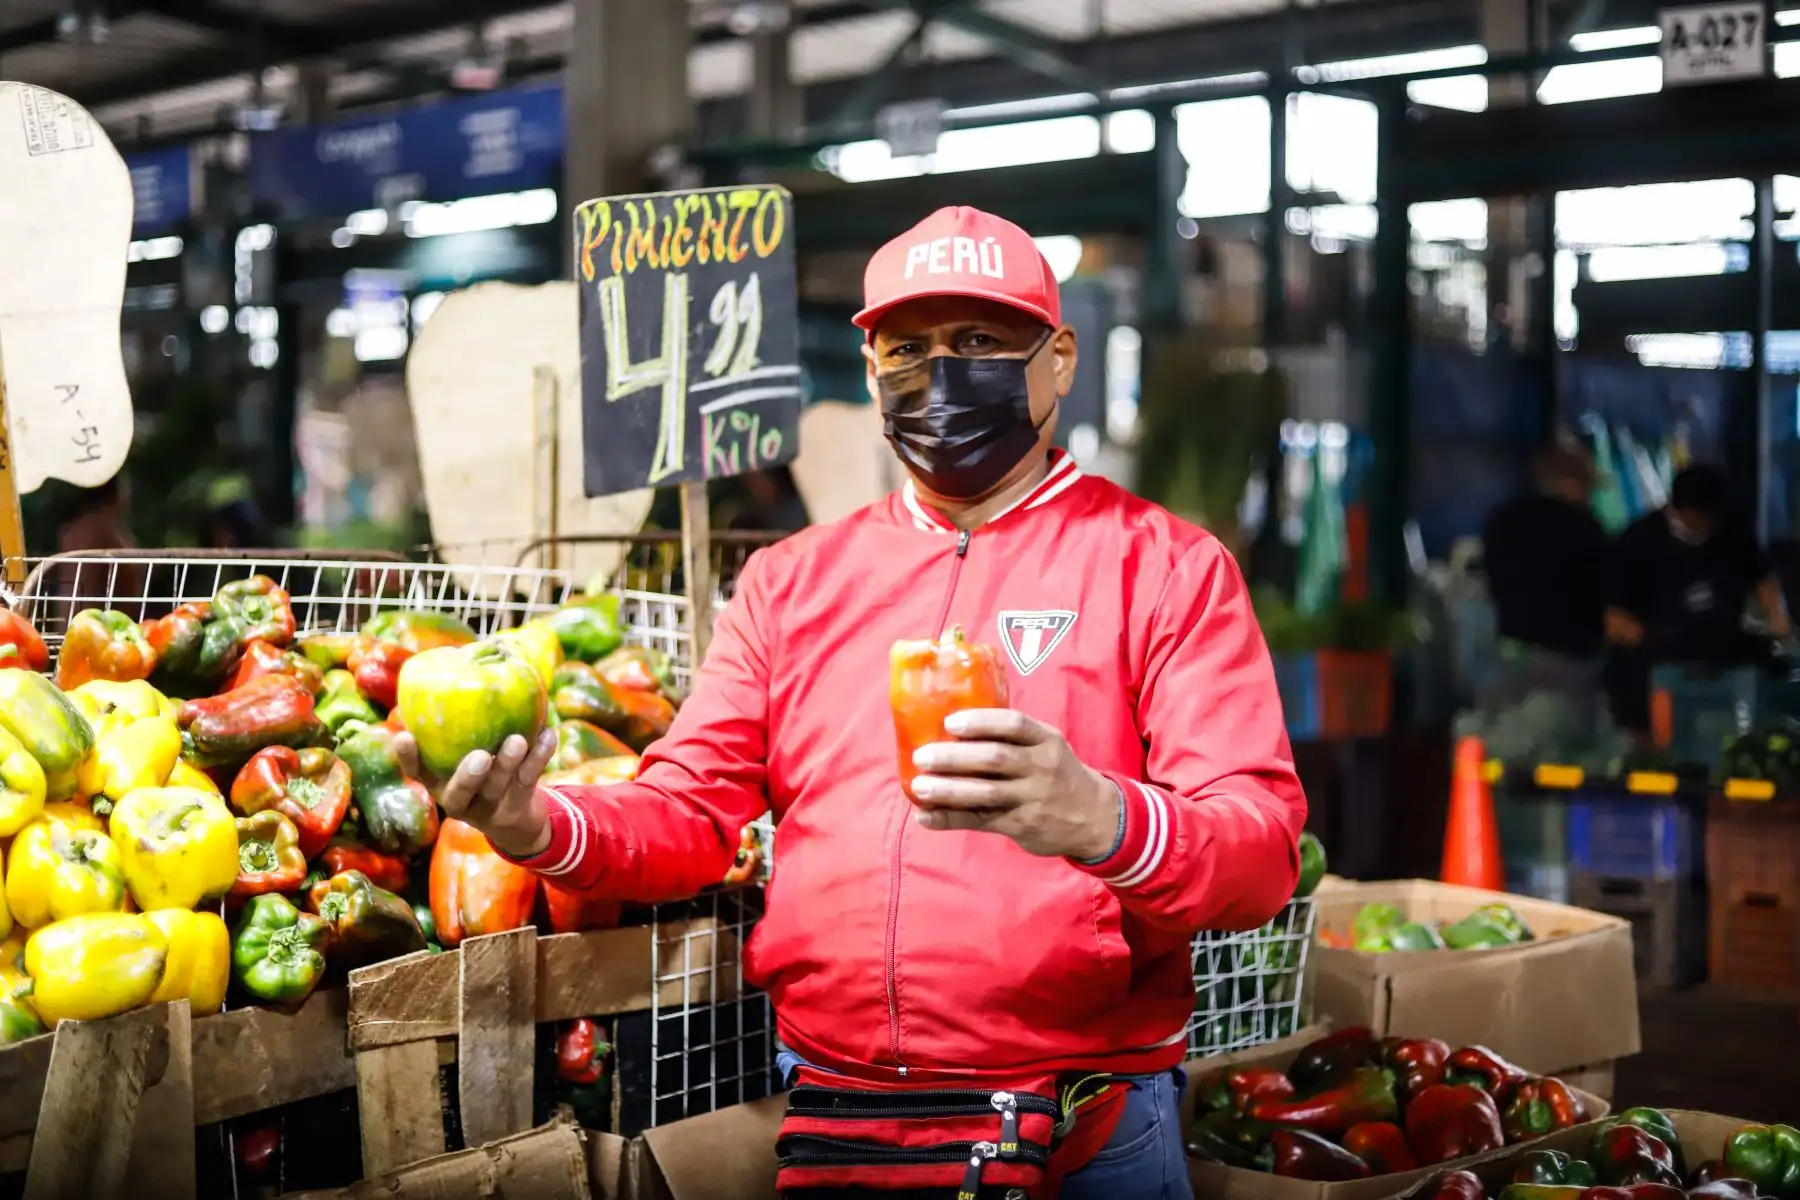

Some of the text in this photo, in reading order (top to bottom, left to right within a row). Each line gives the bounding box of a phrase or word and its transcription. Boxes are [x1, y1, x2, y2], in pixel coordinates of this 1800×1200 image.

[1671, 13, 1758, 51] A-027
[579, 189, 785, 281] PIMIENTO
[904, 236, 1004, 280] PERÚ
[599, 272, 762, 484] 4 99
[1011, 617, 1059, 629] PERU
[1001, 1142, 1017, 1152] CAT
[958, 1191, 975, 1200] CAT
